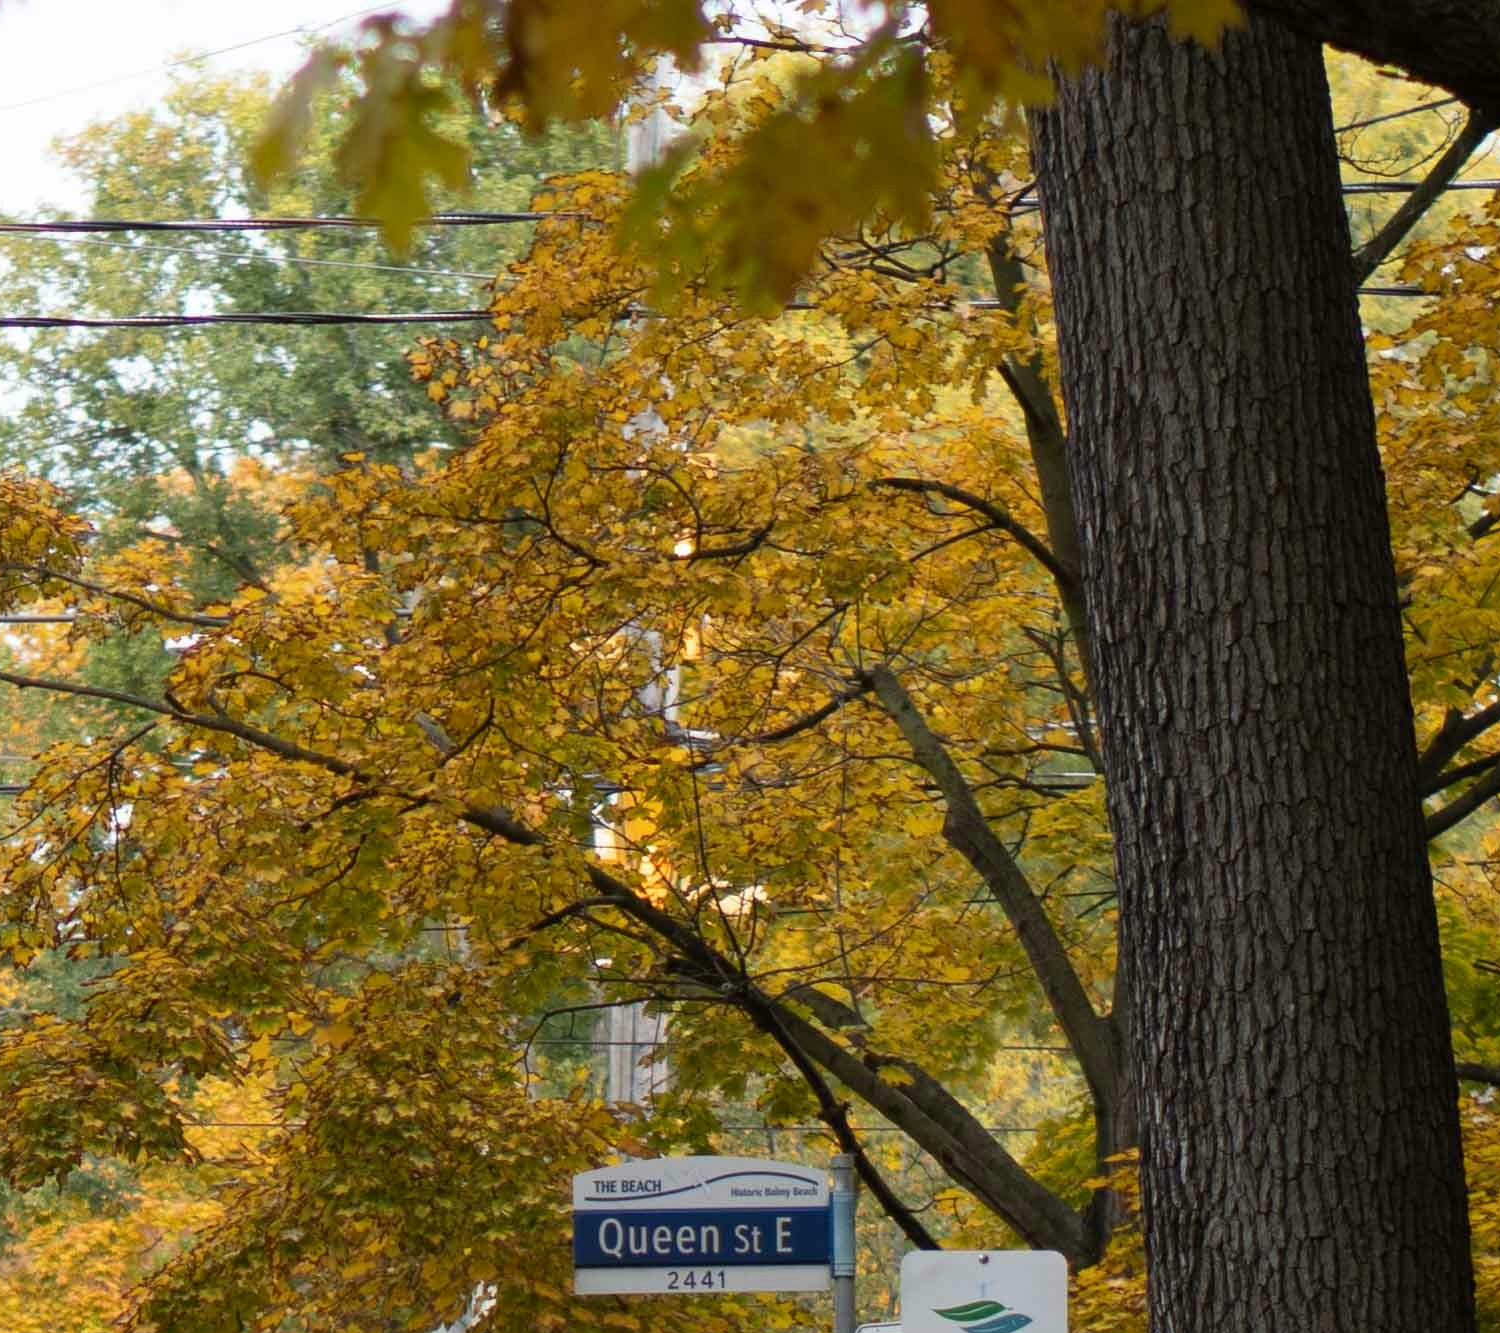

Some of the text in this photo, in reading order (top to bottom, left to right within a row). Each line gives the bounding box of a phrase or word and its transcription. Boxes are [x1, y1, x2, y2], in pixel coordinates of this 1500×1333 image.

[592, 1179, 663, 1193] THE BEACH
[731, 1186, 763, 1197] Historic
[793, 1185, 818, 1196] Beach
[599, 1217, 792, 1259] Queen St E
[667, 1271, 725, 1290] 2441
